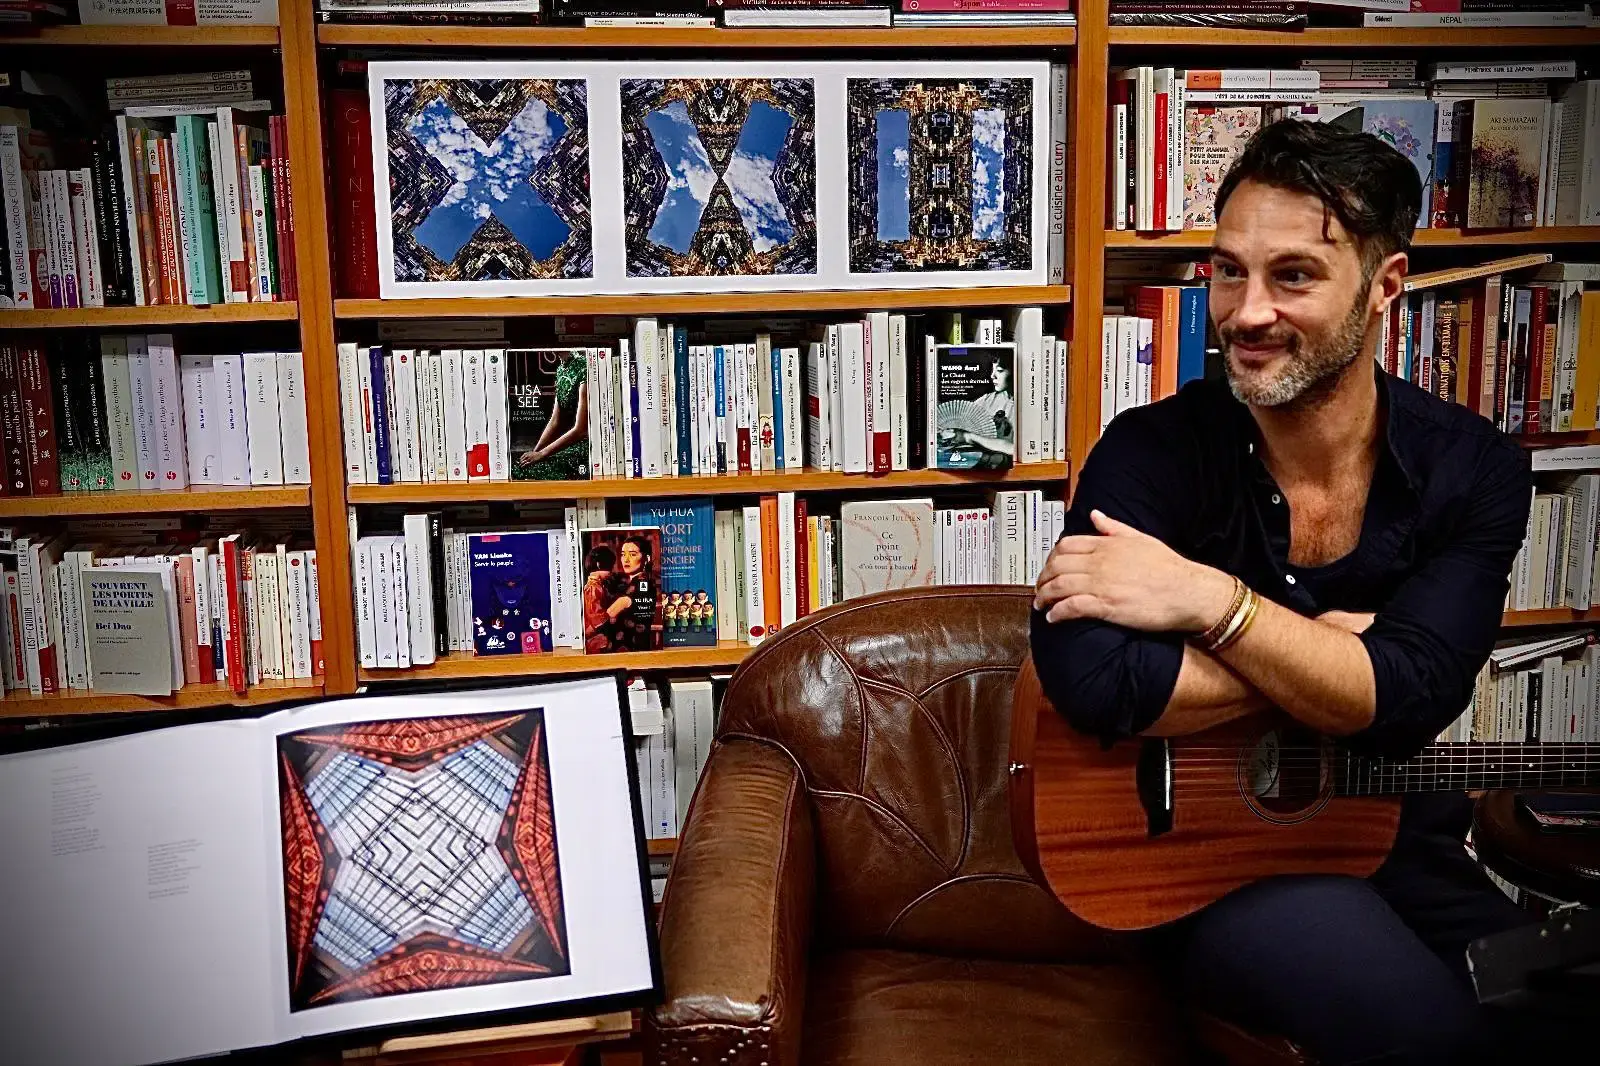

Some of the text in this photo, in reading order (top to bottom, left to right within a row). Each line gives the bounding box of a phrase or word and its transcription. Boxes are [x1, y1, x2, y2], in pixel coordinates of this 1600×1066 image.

[1502, 116, 1538, 124] SHIMAZAKI
[4, 153, 18, 197] CHINOISE
[1051, 140, 1068, 234] La cuisine au curry
[163, 189, 171, 215] ENFANTS
[166, 229, 174, 248] GONG
[14, 250, 24, 270] BIBLE
[169, 258, 175, 267] DU
[1545, 327, 1554, 349] FEMMES
[1439, 313, 1452, 401] GRINATIONS EN BIRMANIE
[111, 377, 120, 403] mythique
[135, 377, 144, 403] mythique
[158, 378, 166, 404] mythique
[515, 385, 541, 396] LISA
[11, 390, 21, 412] peints
[518, 397, 540, 408] SEE
[646, 402, 653, 410] La
[4, 409, 12, 428] grive
[6, 429, 13, 439] La
[651, 507, 695, 518] YU HUA
[854, 514, 888, 522] FRANÇOIS
[1007, 496, 1017, 542] JULLIEN
[663, 536, 683, 544] D'UN
[881, 531, 893, 539] Ce
[660, 544, 702, 553] PRIÉTAIRE
[876, 543, 899, 551] point
[661, 556, 696, 564] ONCIER
[751, 563, 757, 571] LA
[92, 582, 147, 590] S'OUVRENT
[92, 591, 153, 599] LES PORTES
[124, 600, 154, 608] VILLE
[24, 607, 34, 630] CAUTION
[96, 622, 111, 630] Bei
[27, 637, 36, 650] LUST
